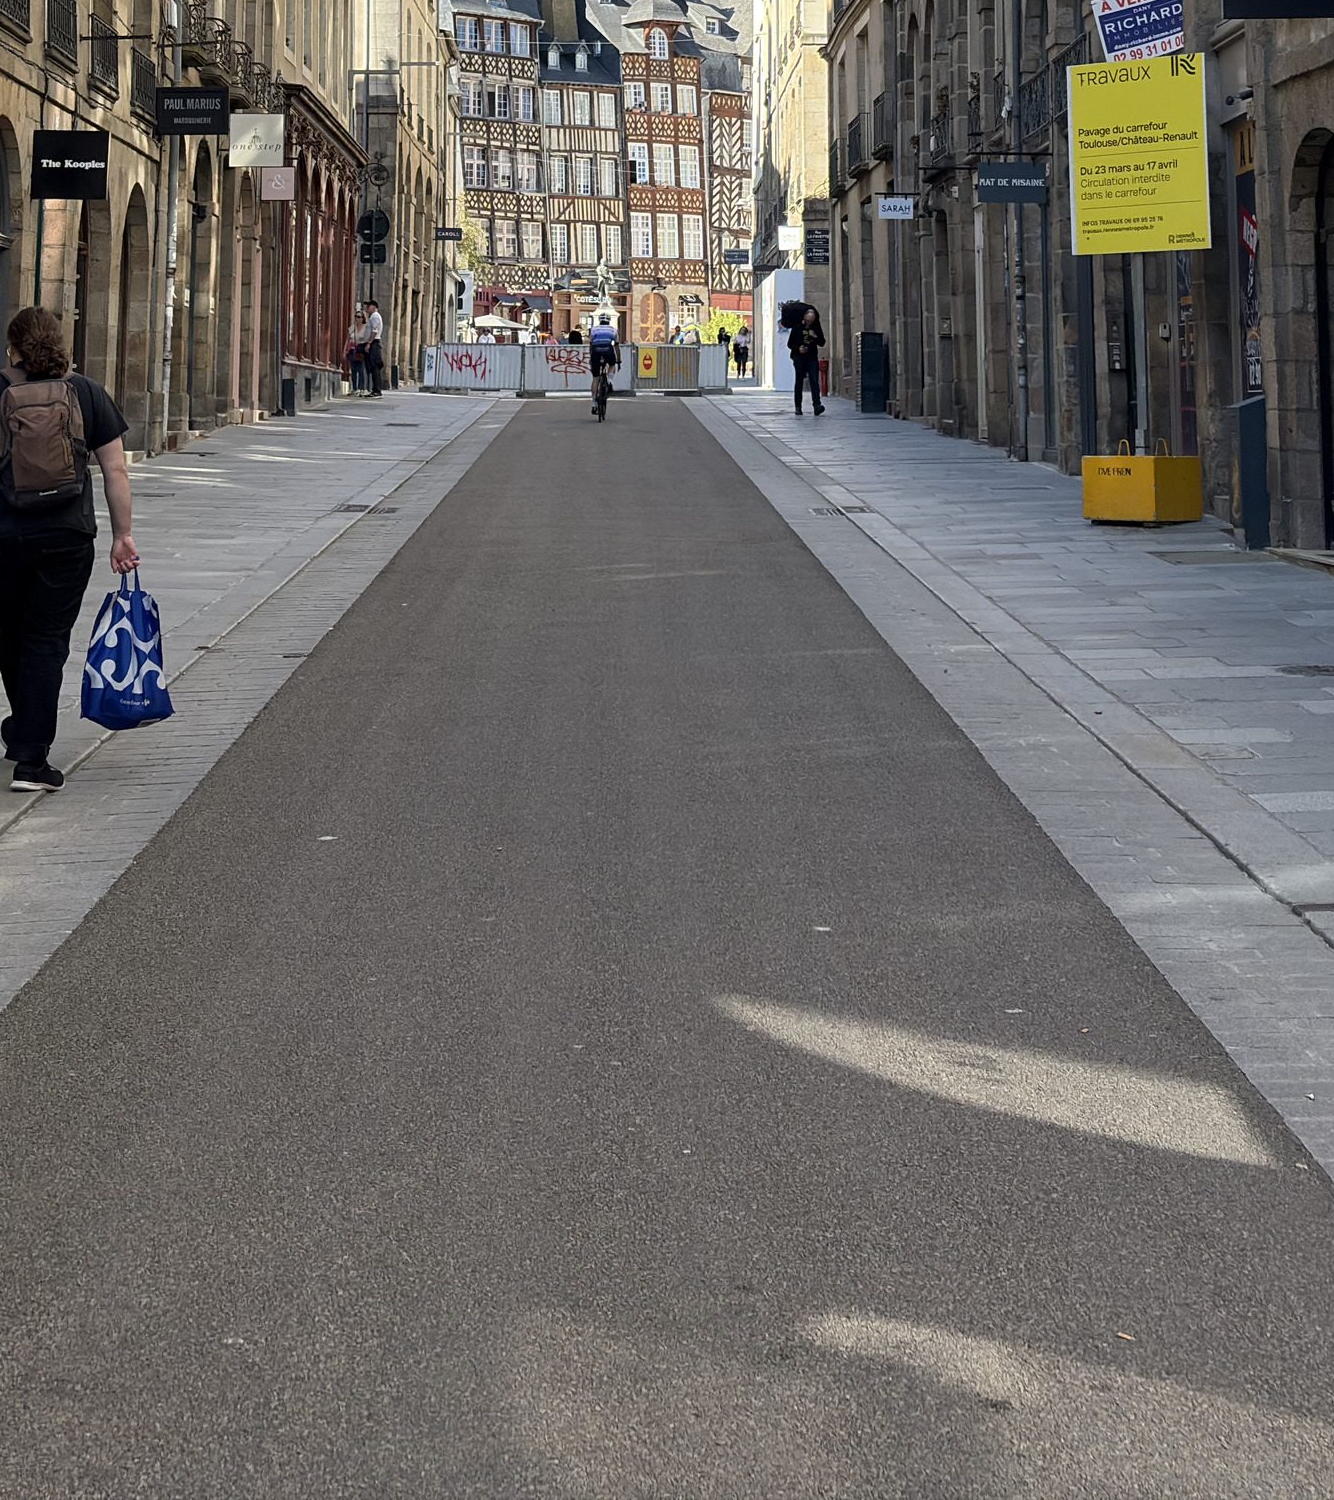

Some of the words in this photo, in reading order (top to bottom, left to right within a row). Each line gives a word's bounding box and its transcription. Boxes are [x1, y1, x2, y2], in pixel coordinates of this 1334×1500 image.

[1101, 0, 1112, 12] À
[1133, 4, 1151, 14] DANY
[1104, 3, 1183, 35] RICHARD
[1130, 48, 1143, 60] 99
[1146, 43, 1158, 56] 31
[1161, 39, 1172, 52] 01
[164, 98, 185, 110] PAUL
[187, 98, 221, 110] MARIUS
[1078, 126, 1111, 138] Pavage
[1112, 125, 1124, 135] du
[1125, 121, 1168, 133] carrefour
[1078, 130, 1199, 150] Toulouse/Château-Renault
[232, 143, 254, 151] one
[258, 142, 282, 153] step
[40, 159, 62, 169] The
[64, 159, 106, 170] Kooples
[1080, 166, 1093, 176] Du
[1094, 165, 1107, 175] 23
[1108, 164, 1132, 174] mars
[1133, 163, 1145, 172] au
[1147, 161, 1156, 170] 17
[1157, 159, 1178, 169] avril
[979, 178, 995, 187] MAT
[997, 178, 1009, 187] DE
[1011, 178, 1045, 187] MISAINE
[1080, 175, 1130, 188] Circulation
[1131, 173, 1171, 184] interdite
[1081, 190, 1103, 201] dans
[1105, 190, 1113, 199] le
[1114, 186, 1157, 199] carrefour
[881, 204, 911, 213] SARAH
[1099, 218, 1124, 226] TRAVAUX
